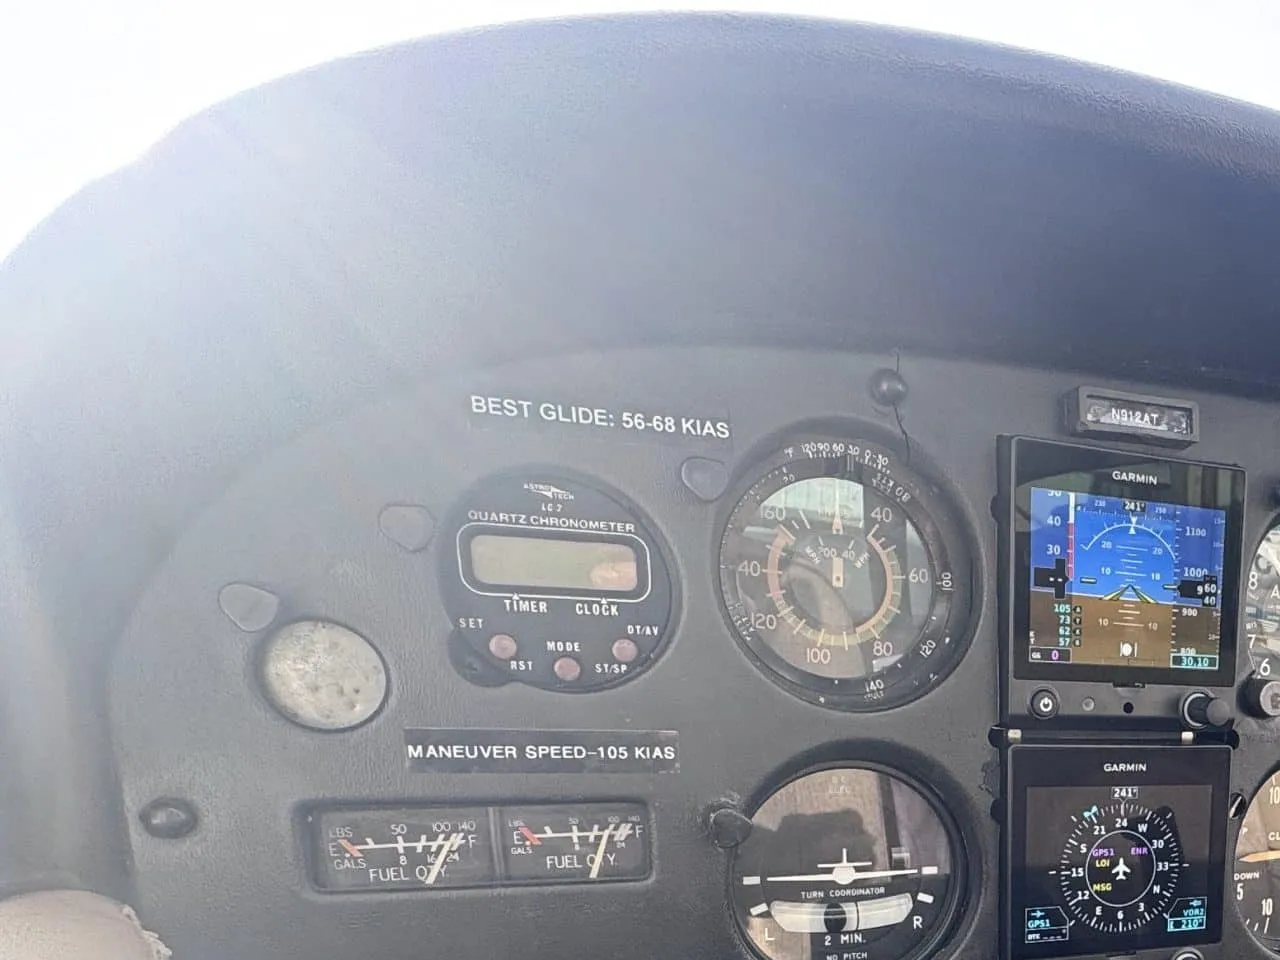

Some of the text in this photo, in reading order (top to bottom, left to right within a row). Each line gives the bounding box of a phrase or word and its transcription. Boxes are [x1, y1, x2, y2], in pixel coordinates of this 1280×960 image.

[471, 396, 730, 438] BEST GLIDE: 56-68 KIAS
[1111, 408, 1159, 425] N912AT
[833, 442, 845, 453] 60
[1112, 470, 1158, 485] GARMIN
[870, 507, 892, 523] 40
[1047, 515, 1061, 526] 40
[468, 511, 636, 533] QUARTZ CHRONOMETER
[1185, 526, 1206, 537] 1100
[1046, 544, 1060, 555] 30
[908, 568, 928, 583] 60
[1248, 572, 1258, 590] 8
[504, 600, 548, 613] TIMER
[576, 603, 619, 616] CLOCK
[1053, 603, 1071, 613] 105
[459, 618, 485, 629] SET
[751, 613, 777, 630] 120
[1059, 615, 1071, 625] 73
[1059, 626, 1071, 635] 62
[547, 641, 581, 652] MODE
[1059, 637, 1070, 646] 57
[1248, 634, 1257, 649] 7
[873, 641, 892, 656] 80
[920, 640, 936, 658] 120
[806, 648, 831, 664] 100
[510, 660, 534, 671] RST
[595, 663, 628, 675] ST/SP
[1260, 658, 1271, 676] 6
[865, 679, 884, 692] 140
[407, 745, 517, 759] MANEUVER
[635, 746, 675, 760] KIAS
[1103, 763, 1147, 772] GARMIN
[1269, 787, 1280, 804] 10
[432, 822, 451, 832] 100
[458, 821, 476, 831] 140
[1115, 818, 1128, 828] 24
[1137, 824, 1148, 833] W
[328, 827, 353, 838] LBS
[390, 824, 407, 835] 50
[635, 825, 644, 838] F
[1093, 826, 1107, 835] 21
[468, 835, 477, 849] F
[514, 831, 523, 845] E
[329, 843, 338, 857] E
[1080, 844, 1087, 853] S
[1151, 840, 1165, 849] 30
[511, 847, 533, 855] GALS
[1092, 848, 1115, 857] GPS1
[334, 857, 367, 871] GALS
[400, 855, 408, 866] 8
[546, 855, 582, 869] FUEL
[1156, 862, 1169, 871] 33
[369, 867, 410, 882] FUEL
[1071, 868, 1084, 877] 15
[1234, 871, 1260, 881] DOWN
[801, 887, 885, 899] TURN COORDINATOR
[1092, 883, 1112, 892] MSG
[1153, 885, 1161, 894] N
[1236, 883, 1244, 901] 5
[1077, 891, 1090, 900] 12
[1095, 906, 1102, 915] E
[1138, 903, 1145, 912] 3
[1261, 898, 1273, 916] 10
[1116, 910, 1124, 919] 6
[913, 916, 923, 930] R
[1027, 919, 1050, 928] GPS1
[765, 928, 775, 941] L
[824, 933, 867, 946] 2 MIN.
[843, 952, 868, 960] PITCH
